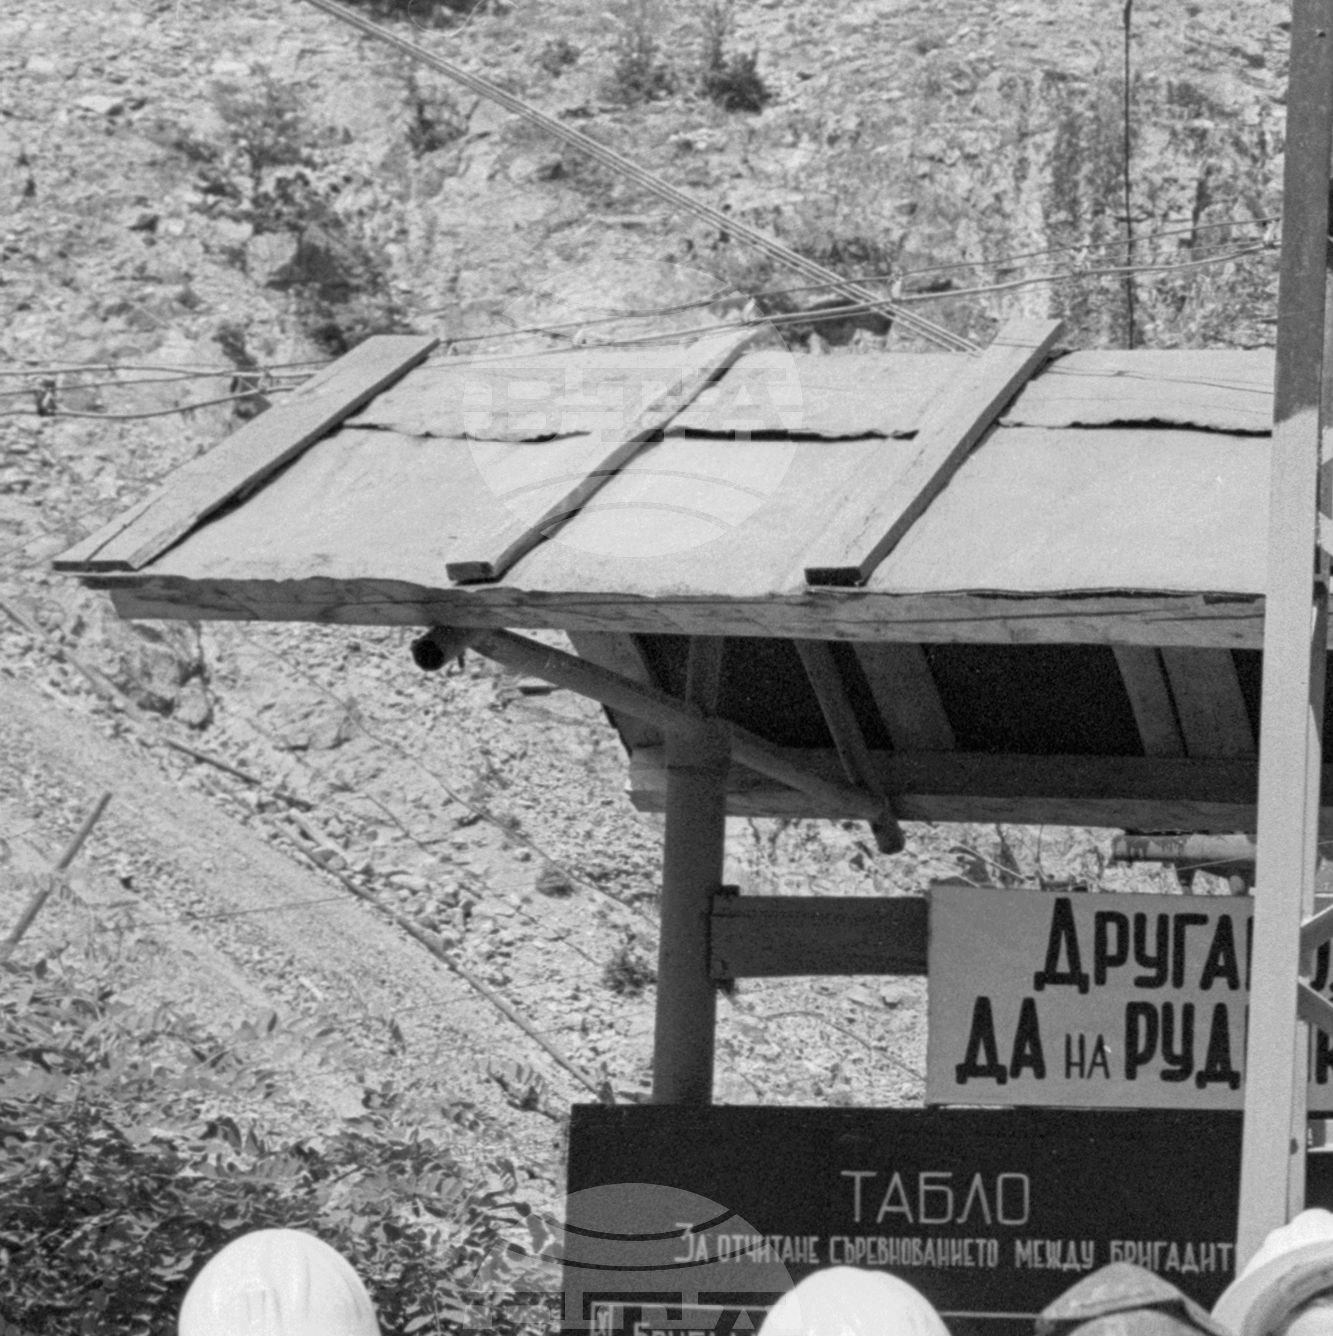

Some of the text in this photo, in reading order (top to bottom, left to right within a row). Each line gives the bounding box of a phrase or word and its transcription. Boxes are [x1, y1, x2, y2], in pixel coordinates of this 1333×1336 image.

[955, 997, 1046, 1086] ДА
[840, 1169, 1030, 1226] ТАБЛО
[716, 1233, 820, 1265] ОТЧИТАНЕ
[1014, 1238, 1095, 1272] МЕЖДУ
[1110, 1239, 1237, 1275] БРИГАДИТ
